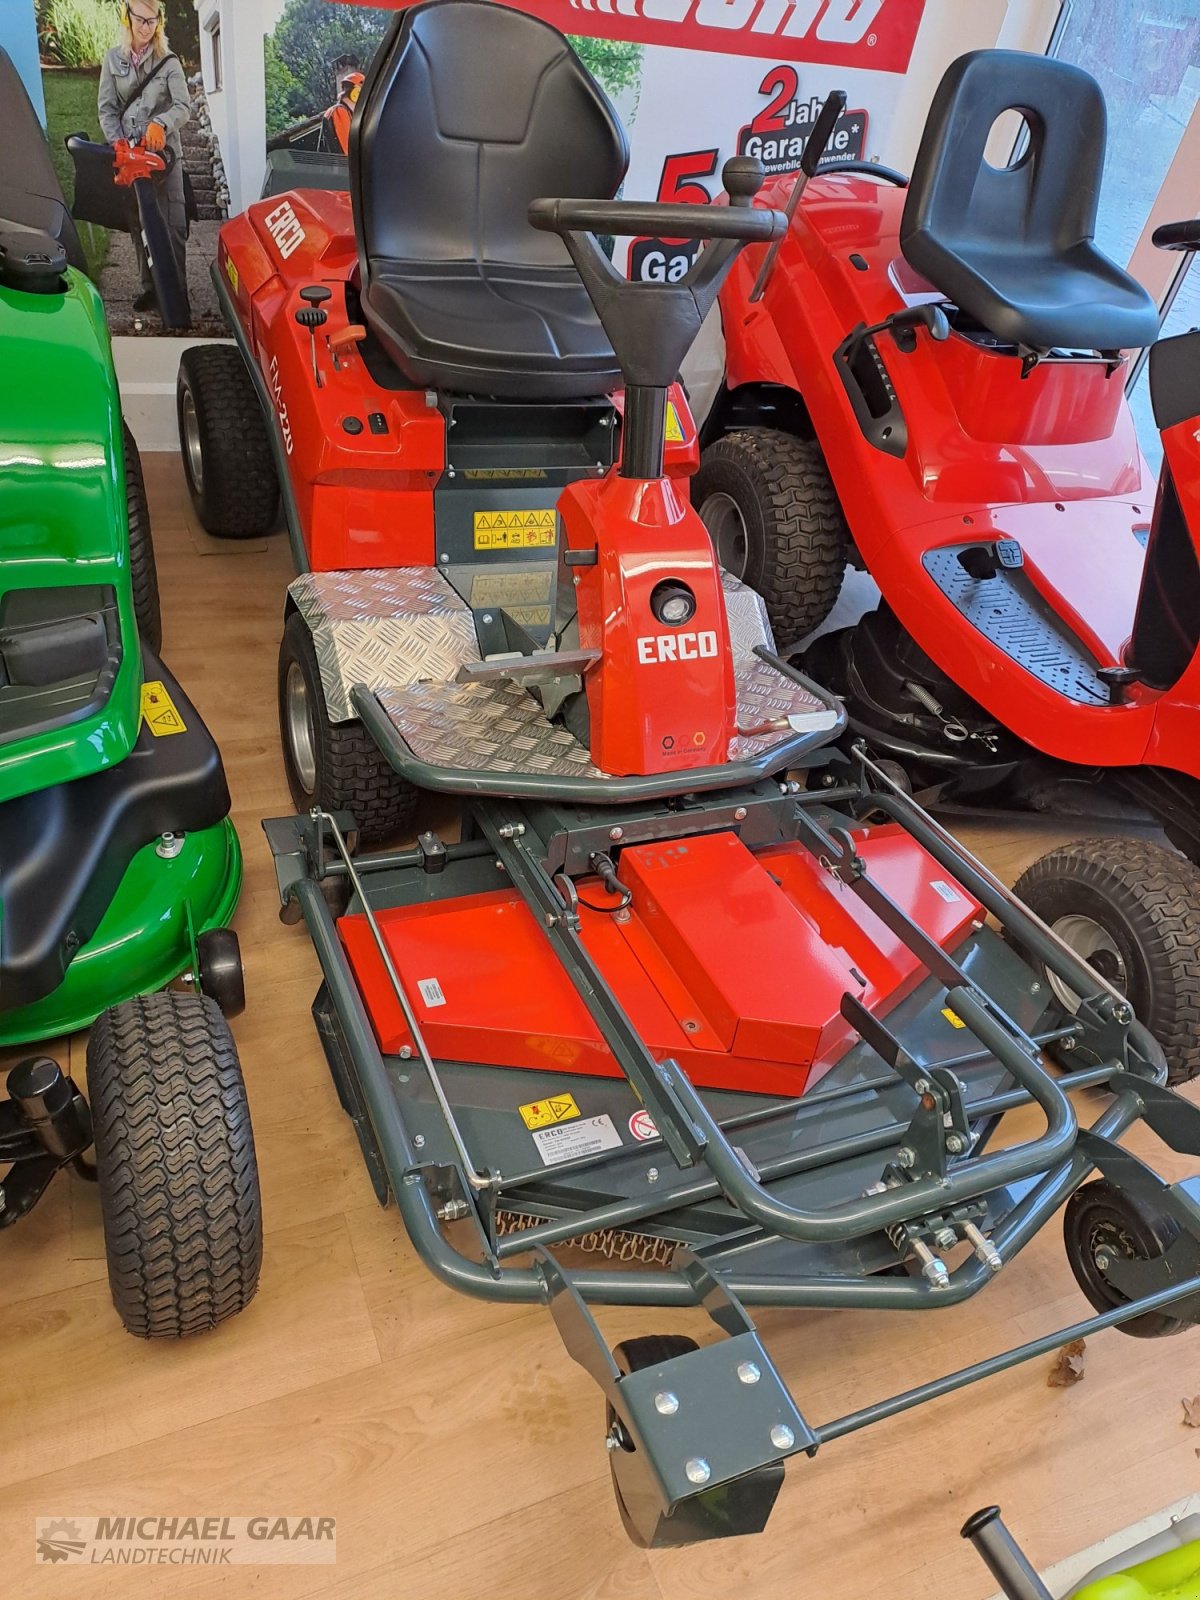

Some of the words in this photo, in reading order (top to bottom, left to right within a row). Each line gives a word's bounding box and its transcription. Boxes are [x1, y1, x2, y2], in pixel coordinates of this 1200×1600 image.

[751, 65, 799, 134] 2
[784, 96, 846, 126] Jah
[264, 200, 306, 260] ERCO
[640, 250, 699, 283] Ga
[269, 355, 293, 455] FM-220
[637, 630, 718, 664] ERCO
[538, 1127, 563, 1140] ERCO
